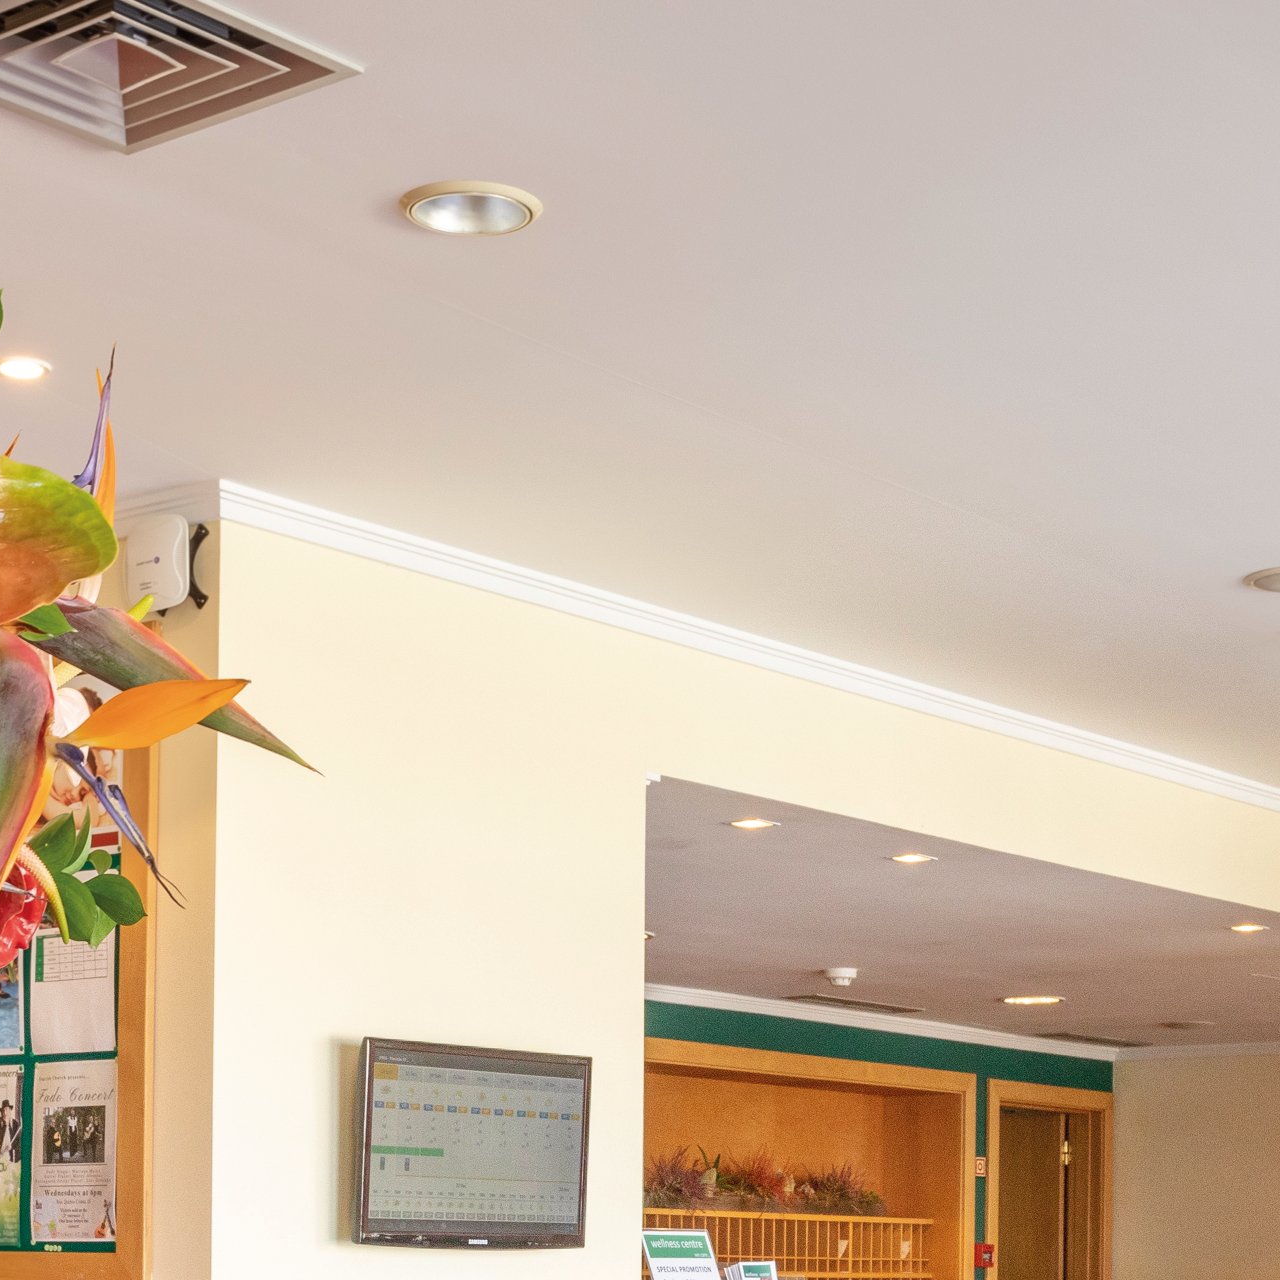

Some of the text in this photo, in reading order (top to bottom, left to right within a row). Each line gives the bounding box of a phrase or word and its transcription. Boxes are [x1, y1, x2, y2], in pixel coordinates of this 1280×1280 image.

[36, 1086, 115, 1104] Fado Concert
[650, 1238, 703, 1249] wellness centre
